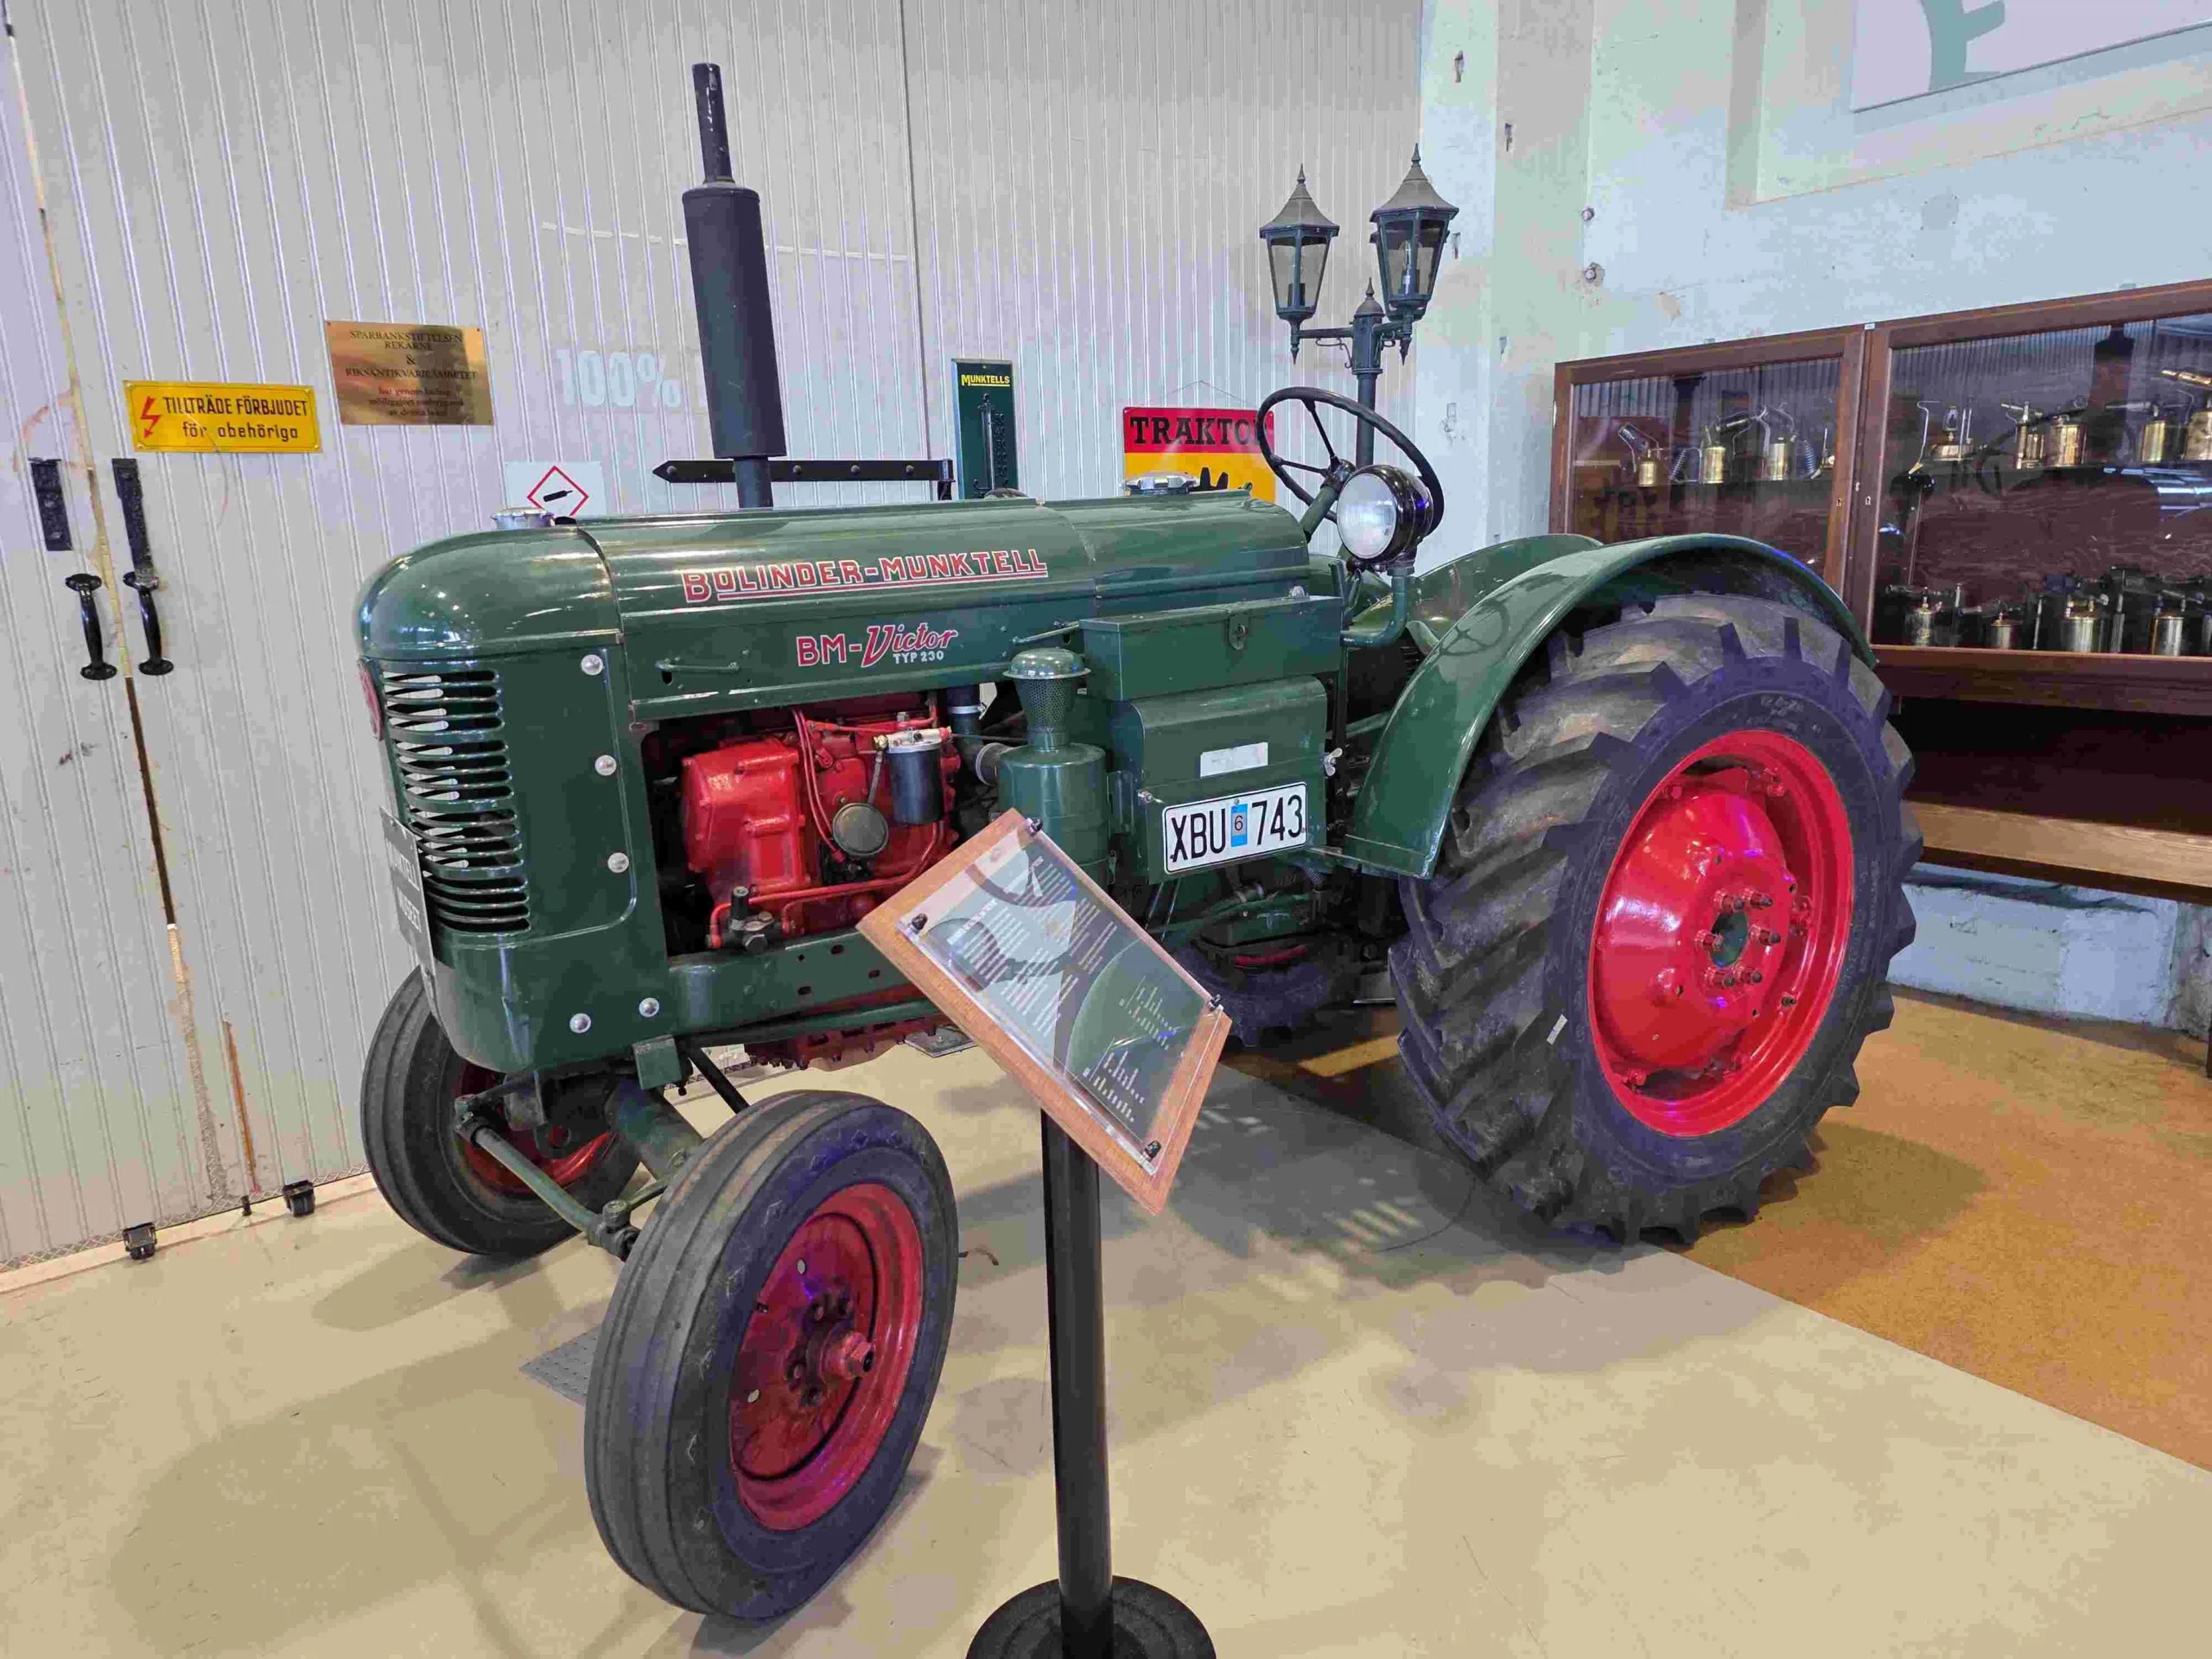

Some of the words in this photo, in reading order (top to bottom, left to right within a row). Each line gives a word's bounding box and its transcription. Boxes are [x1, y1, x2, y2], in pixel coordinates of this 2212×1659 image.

[406, 355, 417, 365] &
[556, 350, 682, 407] 100%
[961, 374, 1010, 386] MUNKTELLS
[163, 395, 232, 415] TILLTRÄDE
[236, 395, 308, 416] FÖRBJUDET
[183, 421, 207, 438] för
[218, 422, 298, 442] obehöriga
[681, 549, 1048, 603] BOLINDER-MUNKTELL
[893, 652, 918, 664] TYP
[920, 650, 944, 662] 230
[1171, 809, 1226, 862] XBU
[1252, 794, 1303, 846] 743
[1234, 815, 1244, 831] 6
